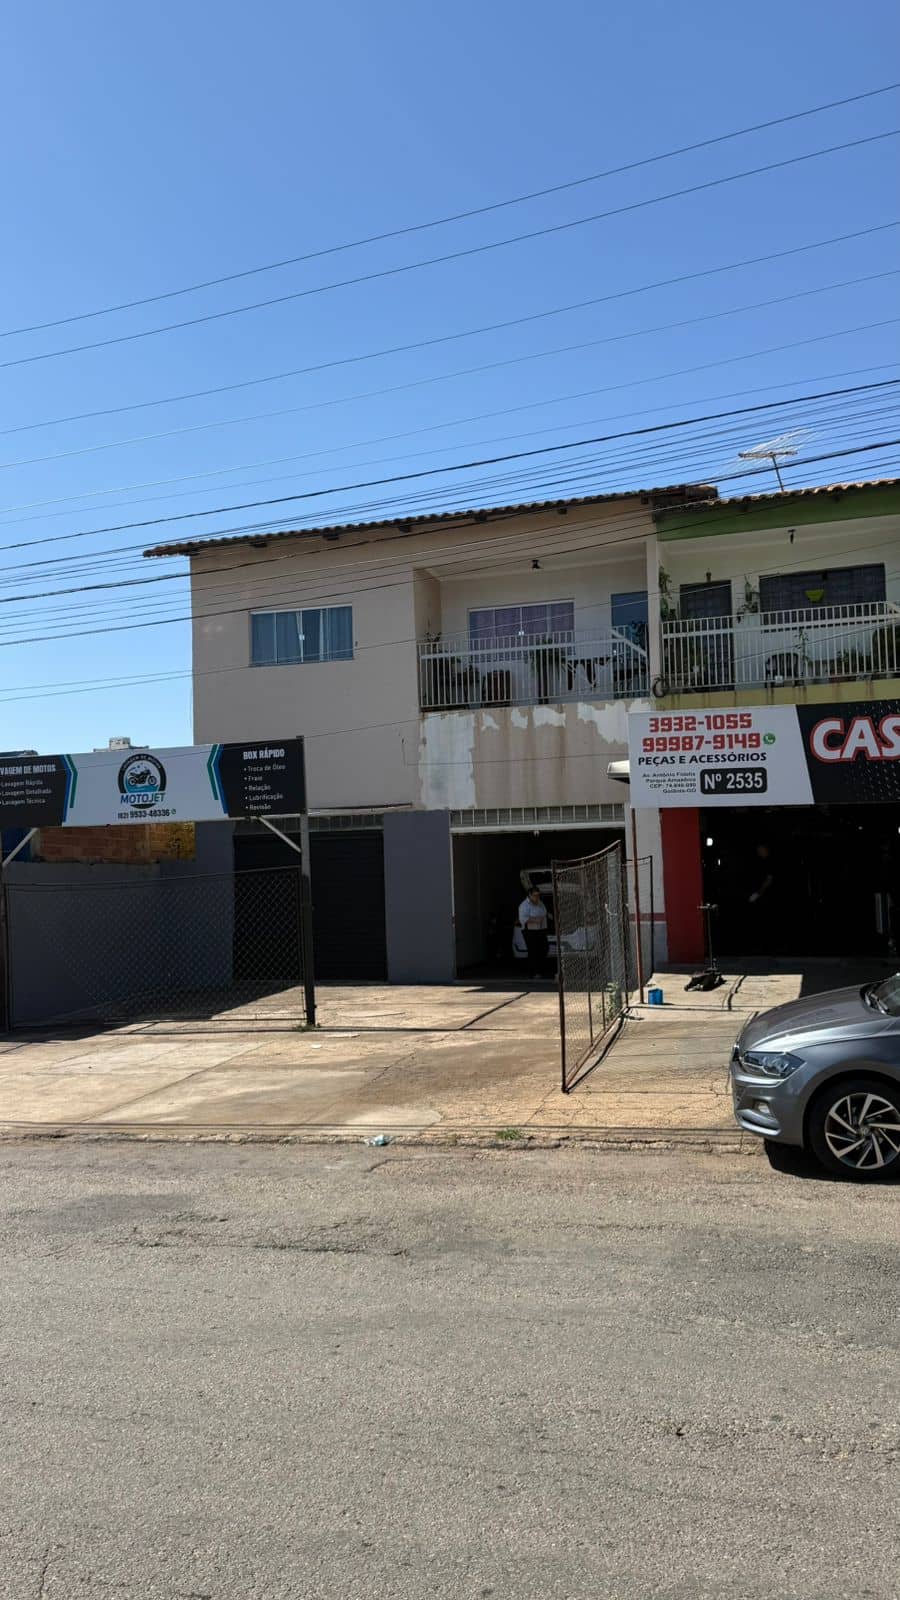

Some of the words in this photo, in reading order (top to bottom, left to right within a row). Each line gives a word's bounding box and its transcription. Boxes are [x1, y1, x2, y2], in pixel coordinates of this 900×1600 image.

[649, 713, 752, 733] 3932-1055
[642, 733, 761, 753] 99987-9149
[243, 751, 258, 760] BOX
[259, 747, 285, 759] RÁPIDO
[638, 755, 676, 767] PEÇAS
[679, 755, 687, 764] E
[689, 751, 767, 764] ACESSÓRIOS
[704, 773, 722, 790] Nº
[726, 772, 763, 789] 2535
[120, 792, 165, 805] MOTOJET
